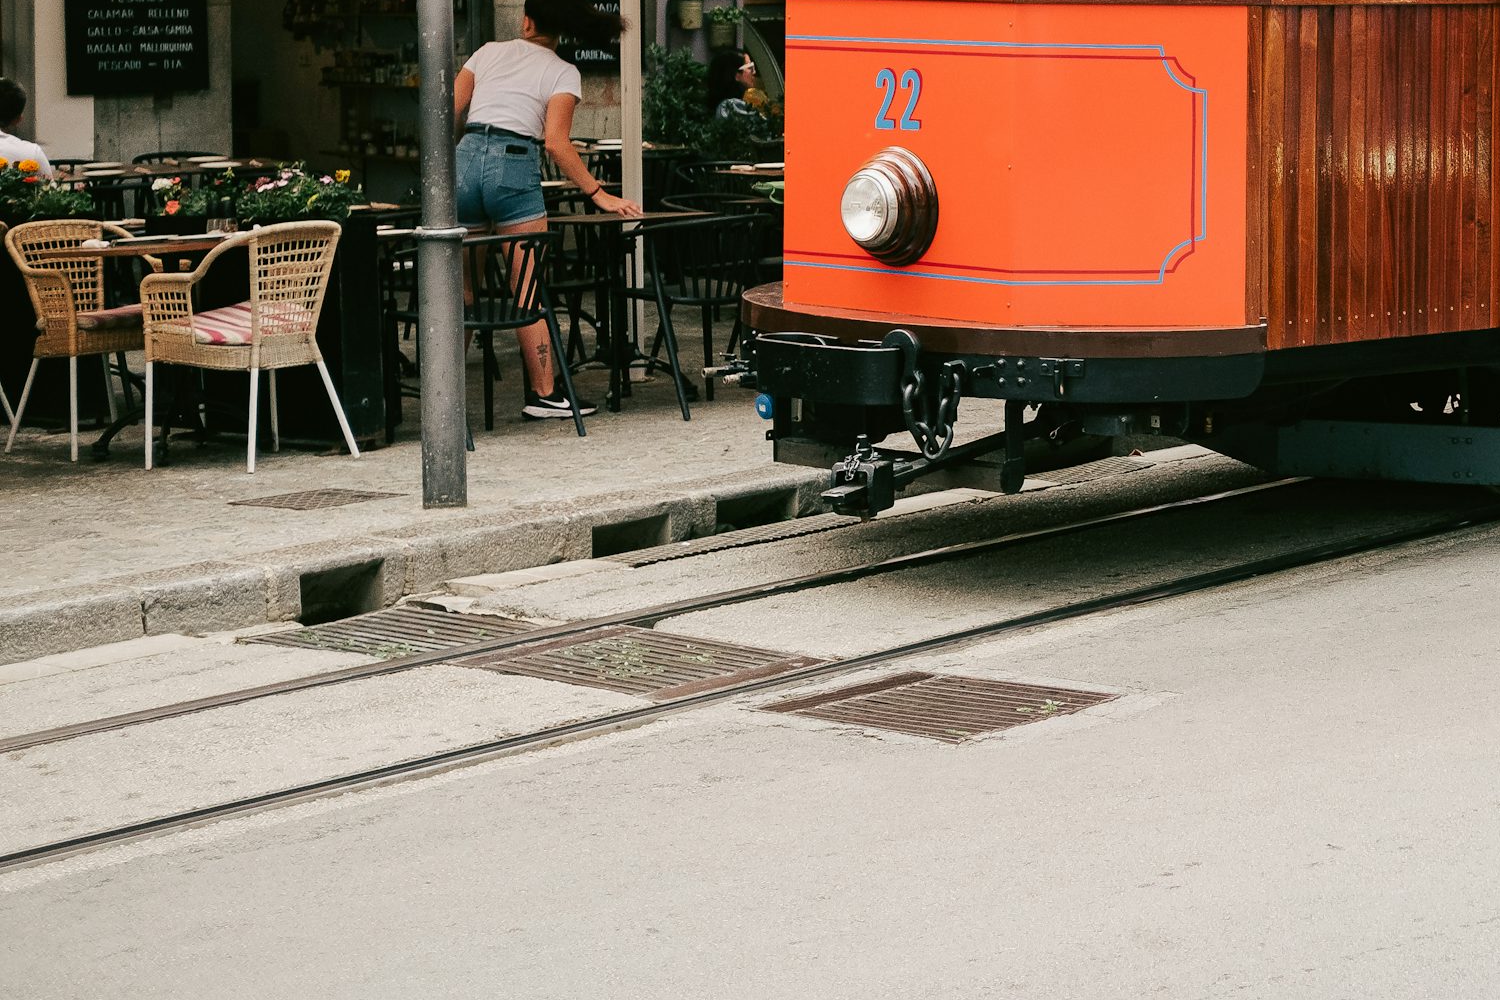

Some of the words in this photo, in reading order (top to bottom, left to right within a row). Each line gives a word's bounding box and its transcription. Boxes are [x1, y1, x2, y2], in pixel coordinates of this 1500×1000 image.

[87, 9, 134, 19] CALAMAR
[148, 8, 189, 19] RELLENO
[87, 26, 122, 37] GALLO
[86, 43, 132, 54] BACALAO
[97, 60, 141, 71] PESCADO
[874, 67, 923, 131] 22
